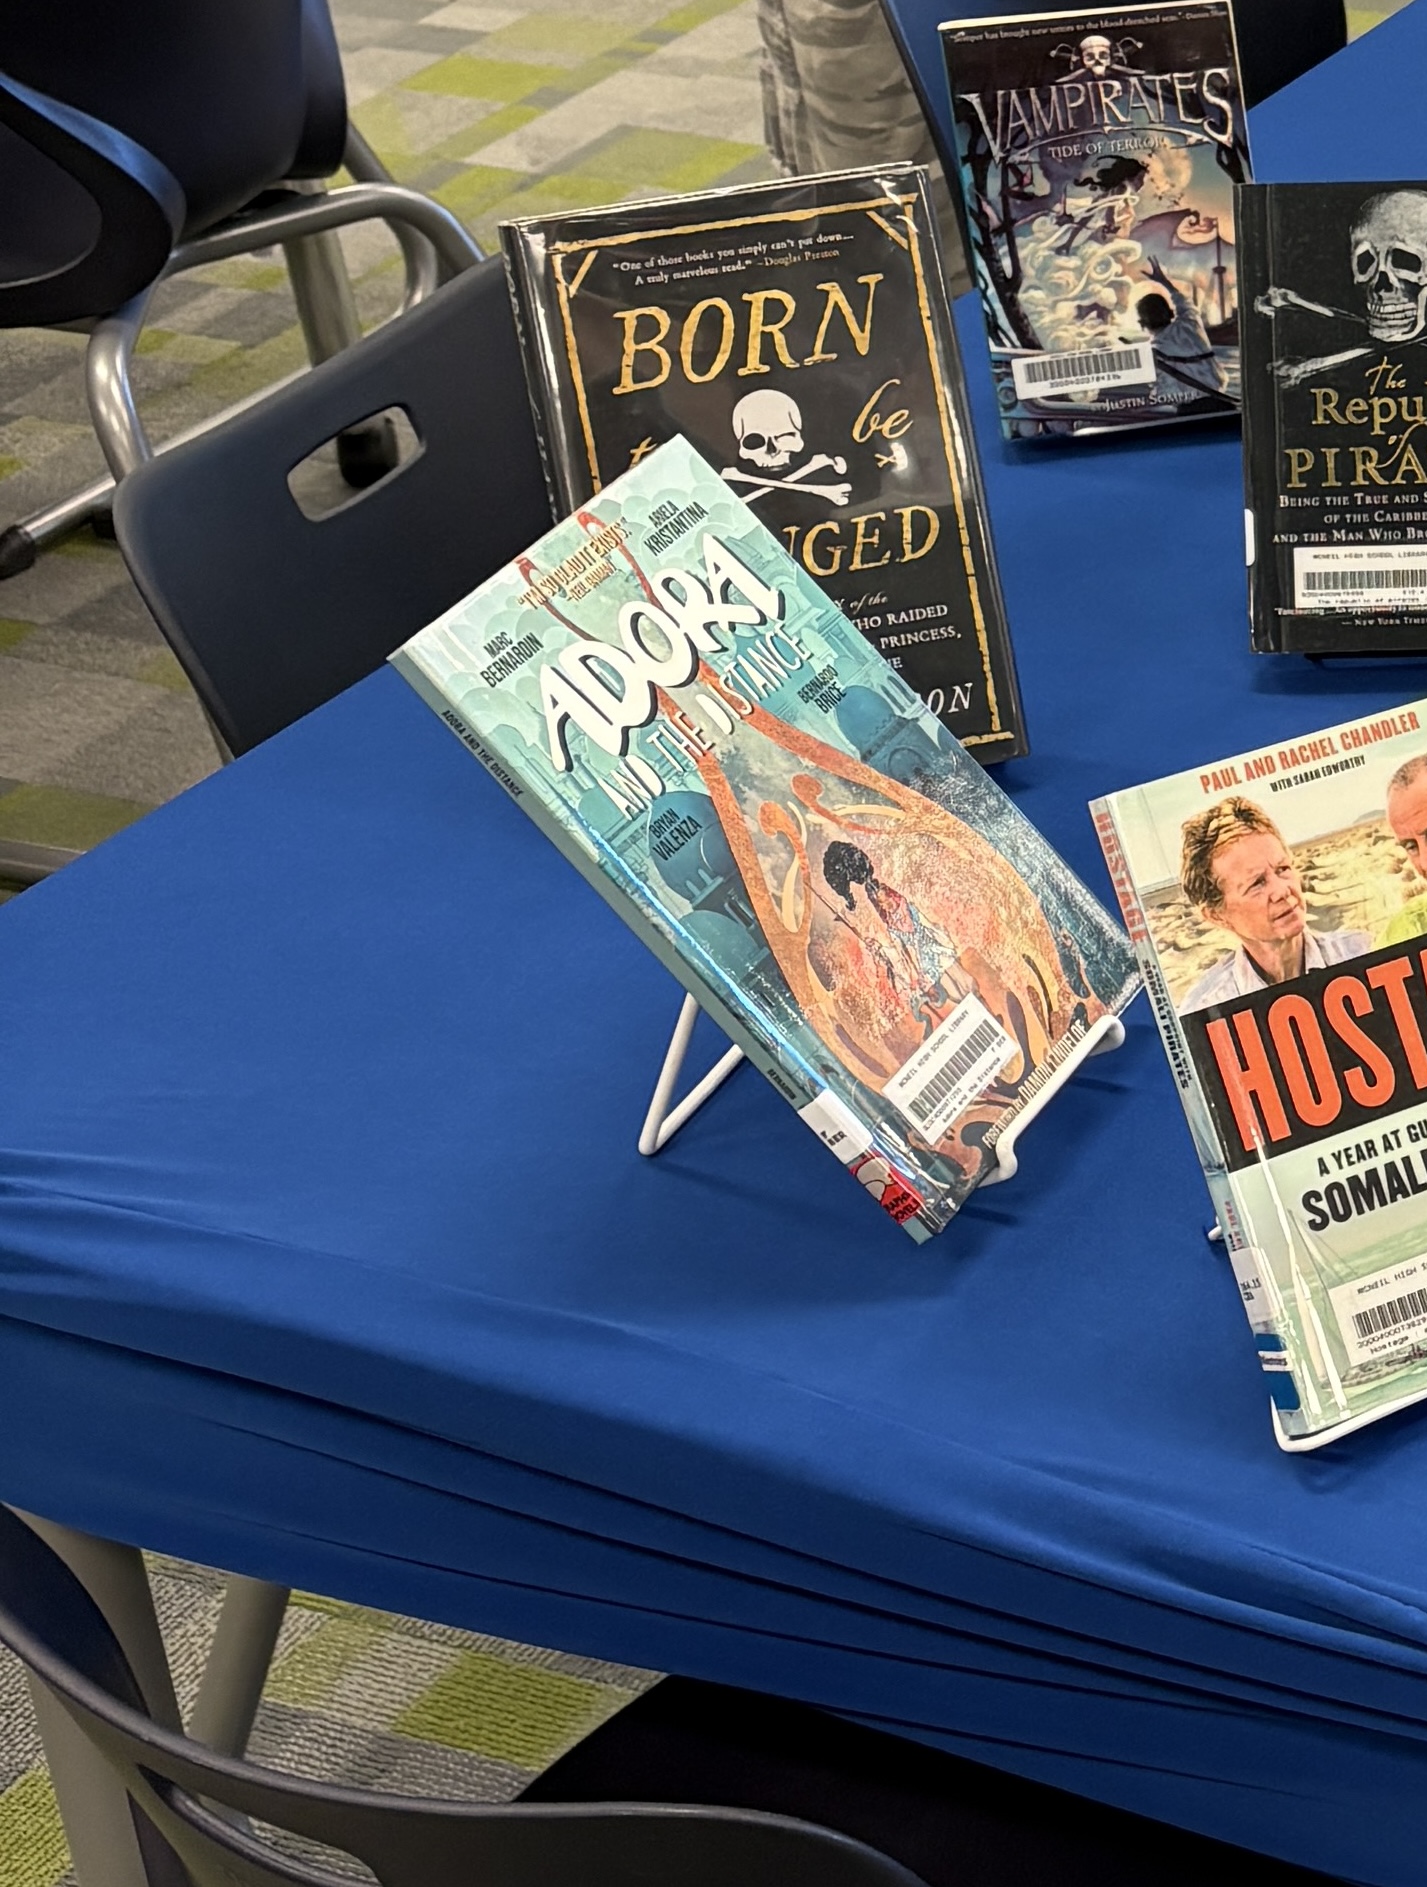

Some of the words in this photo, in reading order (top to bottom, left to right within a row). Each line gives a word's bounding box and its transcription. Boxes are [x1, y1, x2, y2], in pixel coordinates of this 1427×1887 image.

[955, 67, 1234, 166] VAMPIRATES
[1048, 146, 1083, 159] TIDE
[1085, 143, 1104, 155] OF
[1109, 137, 1167, 153] TERROR
[635, 275, 645, 286] A
[647, 270, 670, 284] truly
[673, 264, 719, 280] marvelous
[804, 249, 840, 261] Preston
[644, 258, 655, 268] of
[658, 255, 683, 266] those
[685, 251, 714, 263] books
[717, 248, 735, 260] you
[738, 242, 768, 258] simply
[798, 236, 813, 249] put
[611, 273, 883, 397] BORN
[851, 379, 915, 444] be
[1279, 495, 1320, 508] BEING
[1325, 496, 1350, 506] THE
[1354, 493, 1389, 505] TRUE
[1393, 493, 1419, 504] AND
[1323, 514, 1341, 524] OF
[1345, 513, 1370, 524] THE
[643, 501, 710, 557] KRISTANTINA
[782, 505, 940, 576] GED
[1272, 533, 1299, 543] AND
[1303, 532, 1328, 542] THE
[1331, 529, 1364, 542] MAN
[1369, 528, 1402, 541] WHO
[850, 594, 865, 614] of
[867, 590, 888, 605] the
[886, 604, 949, 626] RAIDED
[483, 630, 515, 659] MARC
[540, 534, 787, 773] ADORA
[880, 625, 962, 650] PRINCESS,
[479, 631, 545, 689] BERNARDIN
[797, 664, 838, 704] BERNARDO
[816, 680, 848, 714] BRICE
[597, 753, 667, 821] AND
[646, 709, 715, 774] THE
[695, 619, 815, 736] DISTANCE
[441, 710, 467, 735] ADORA
[463, 733, 480, 750] AND
[477, 749, 494, 765] THE
[490, 762, 524, 797] DISTANCE
[1199, 766, 1243, 794] PAUL
[1243, 754, 1277, 781] AND
[1278, 736, 1339, 771] RACHEL
[1339, 711, 1421, 751] CHANDLER
[1270, 776, 1293, 793] WITH
[1293, 767, 1321, 787] SARAH
[1321, 754, 1366, 777] EDWORTHY
[649, 808, 681, 839] BRYAN
[652, 815, 703, 861] VALENZA
[1162, 1021, 1190, 1091] PIRATES
[827, 1130, 848, 1147] BER
[1316, 1157, 1330, 1177] A
[1331, 1141, 1379, 1172] YEAR
[1381, 1129, 1402, 1153] AT
[1356, 1275, 1391, 1296] MCNEIL
[1393, 1266, 1418, 1283] HIGH
[1369, 1333, 1410, 1355] Hostage
